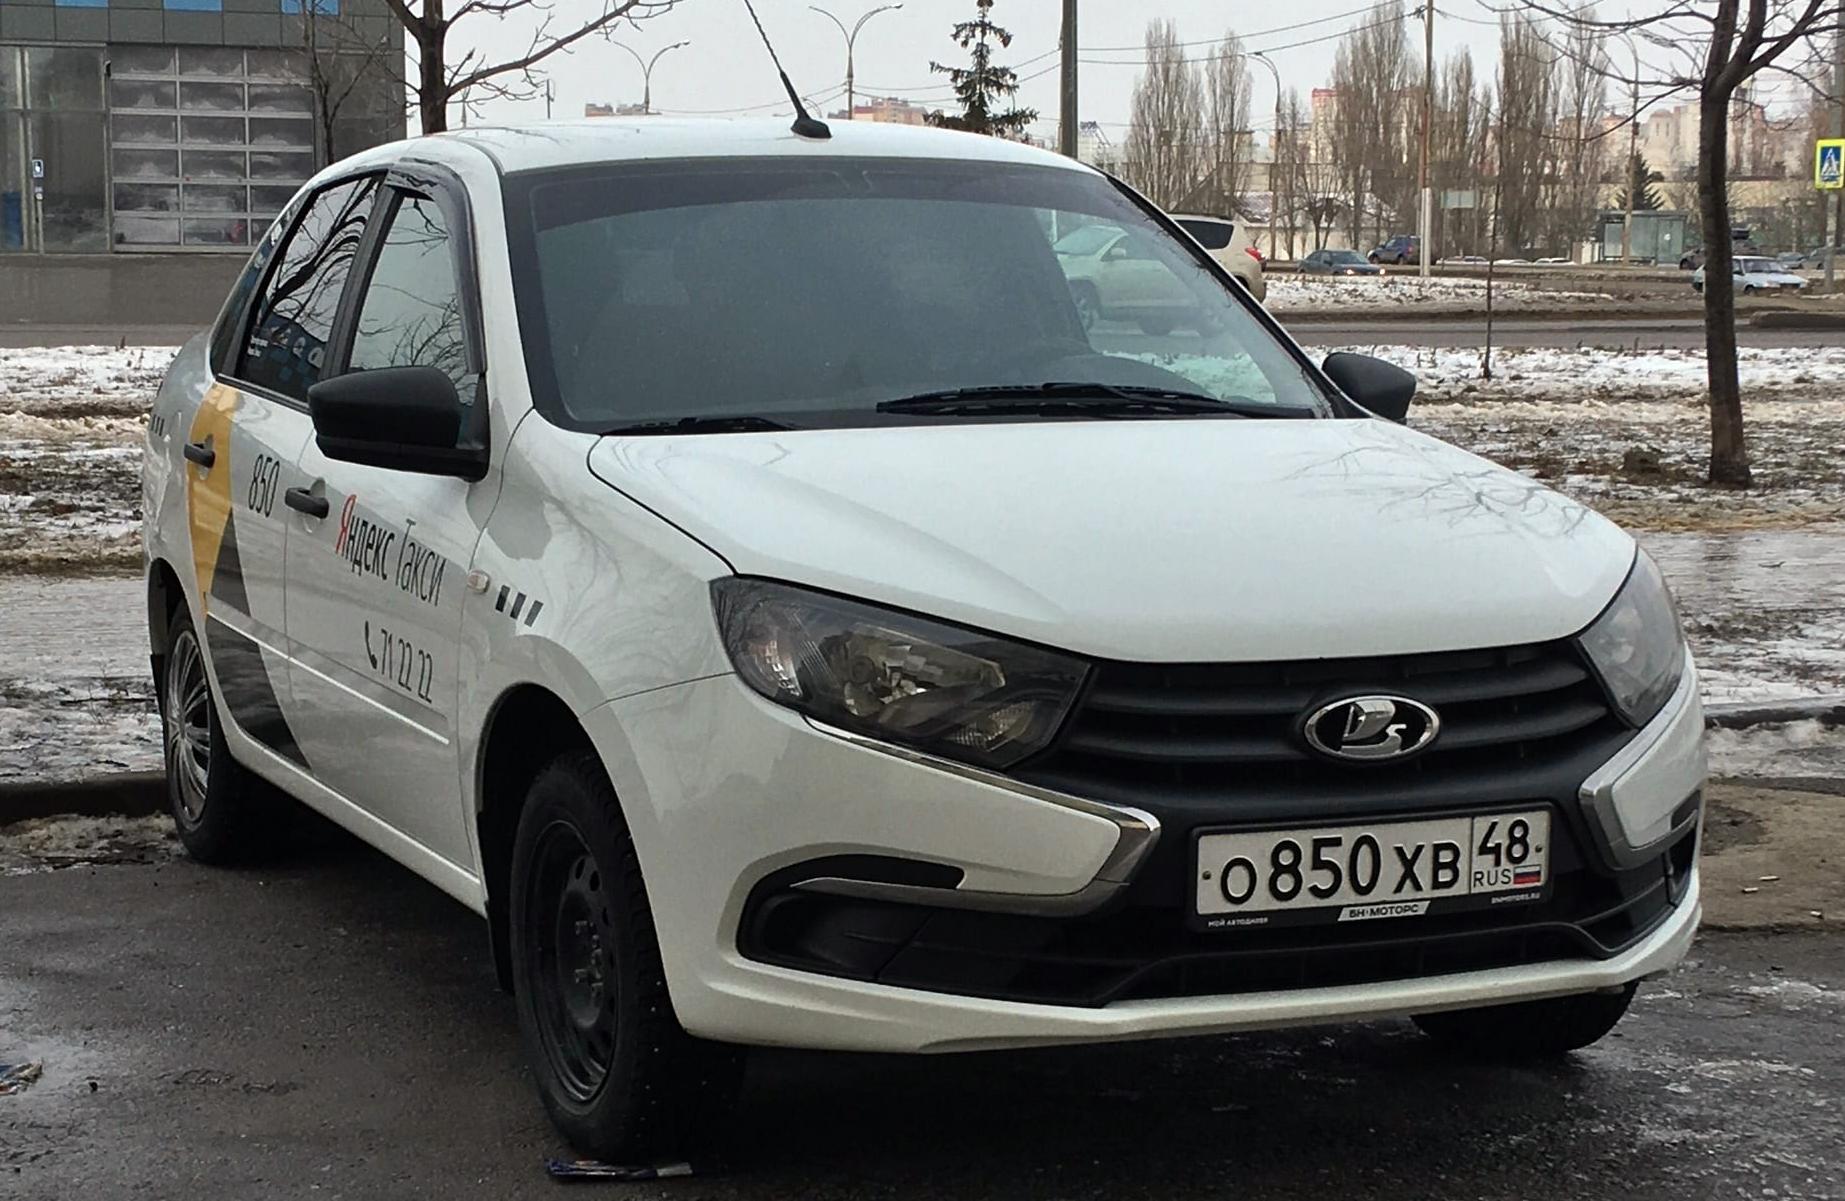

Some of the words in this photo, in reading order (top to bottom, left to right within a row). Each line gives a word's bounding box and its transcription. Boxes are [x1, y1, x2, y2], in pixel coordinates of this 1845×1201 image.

[248, 454, 280, 518] 850
[335, 494, 395, 581] Яндекс
[395, 518, 447, 607] Такси
[381, 628, 392, 680] 71
[398, 637, 412, 692] 22
[418, 649, 432, 704] 22
[1478, 819, 1530, 868] 48
[1473, 868, 1512, 888] RUS
